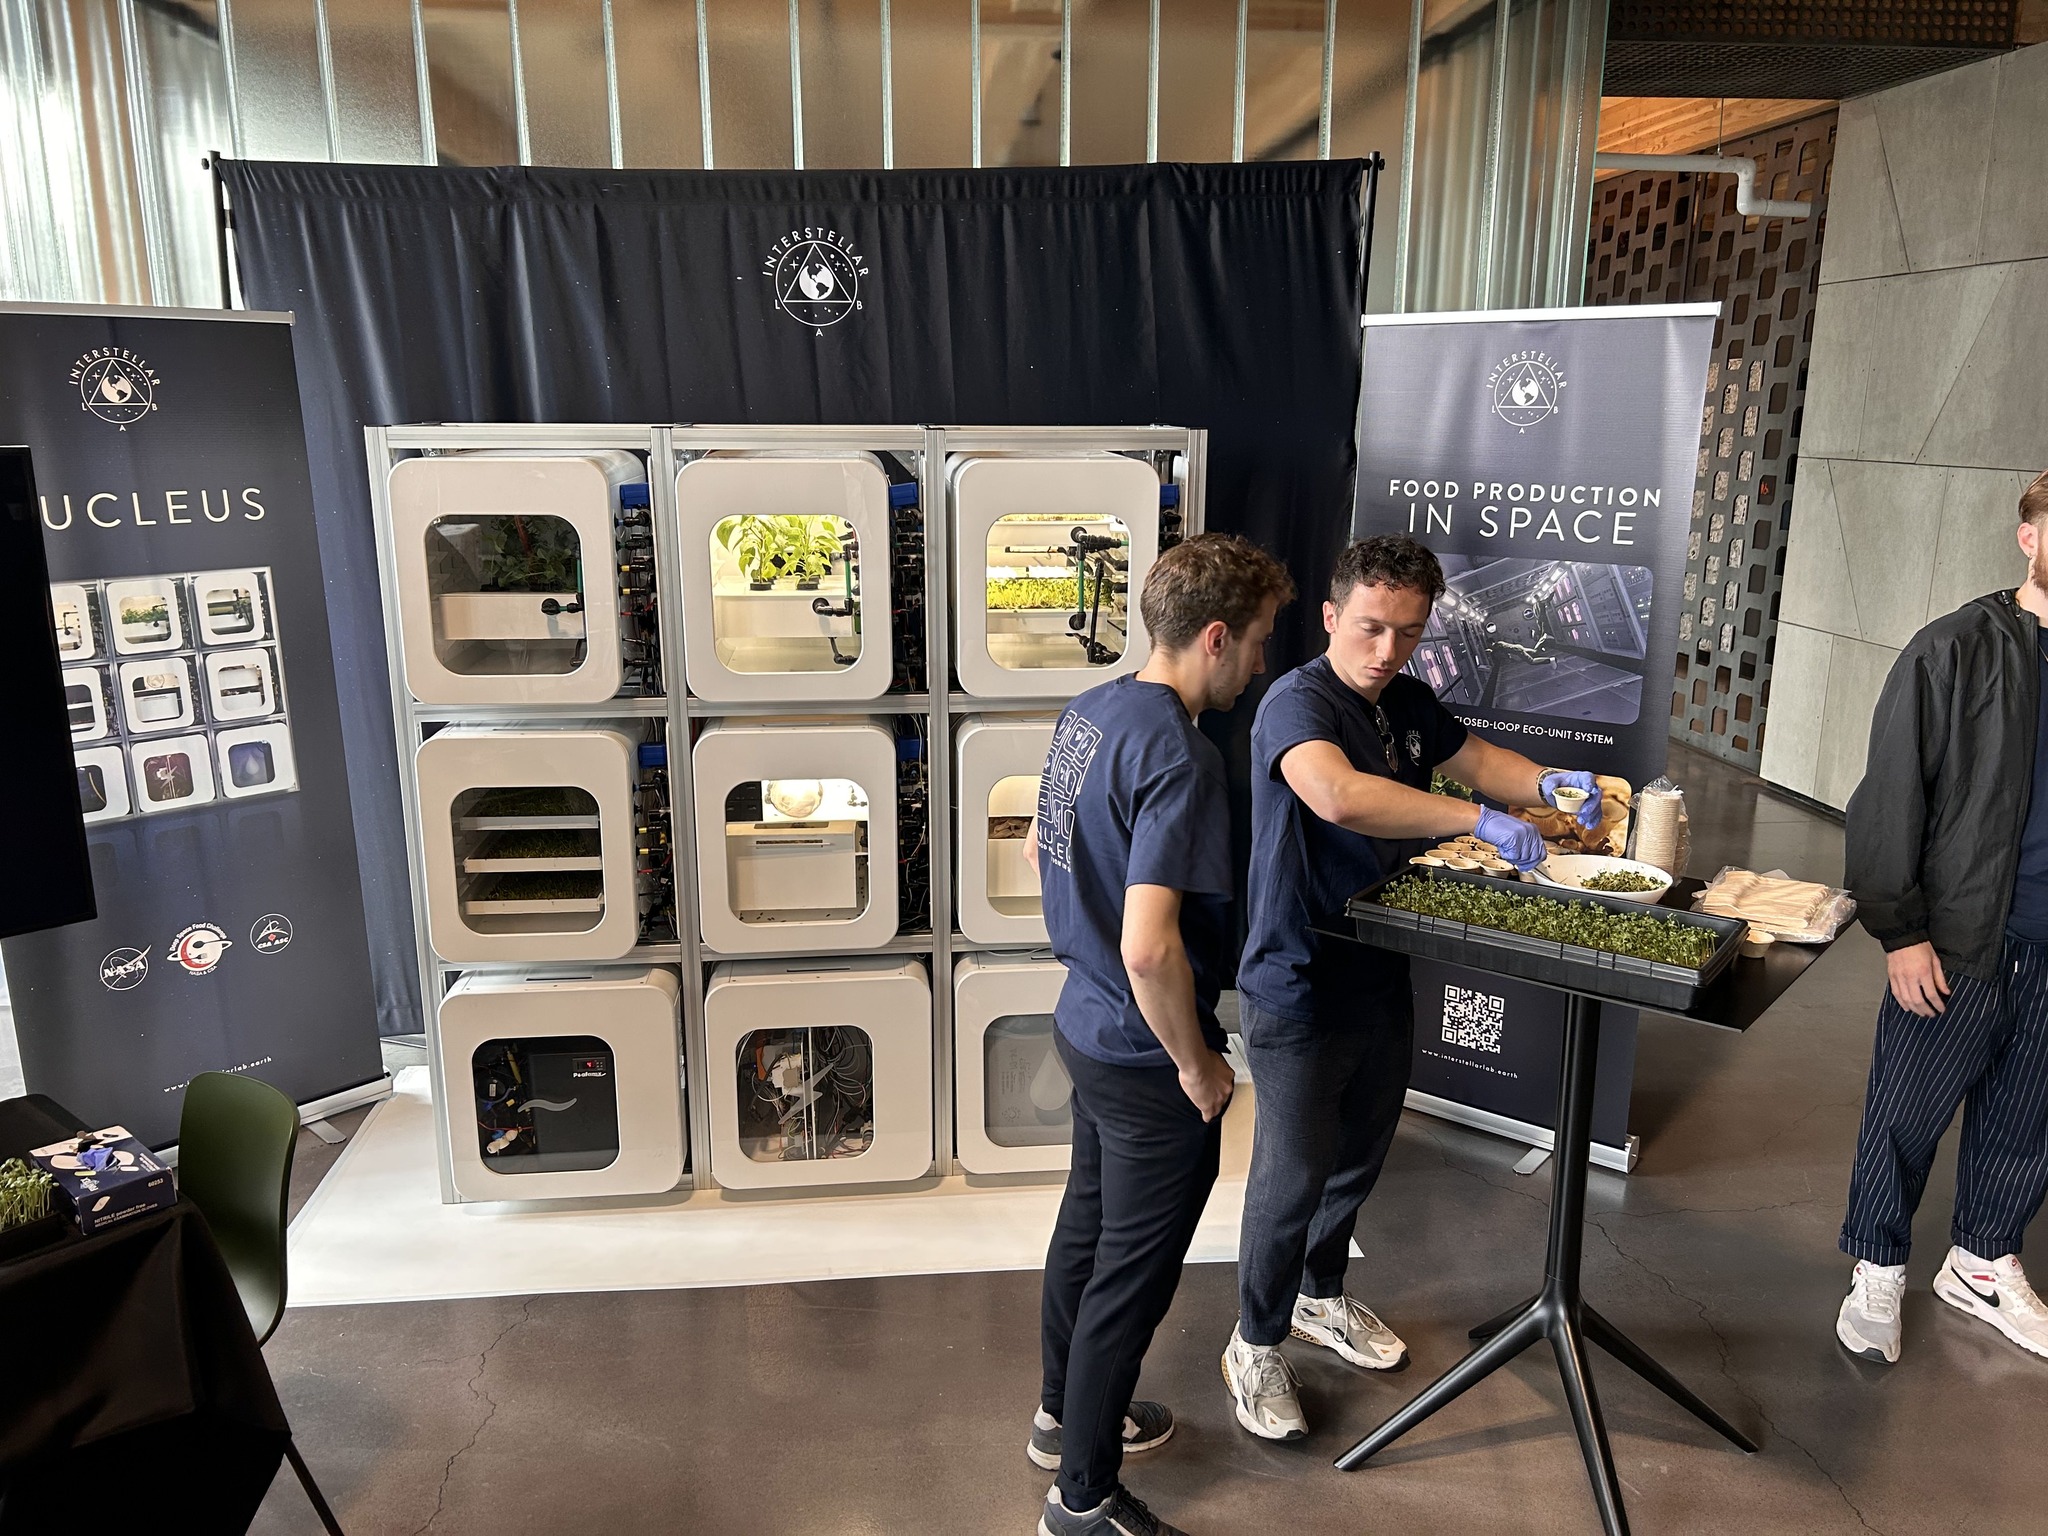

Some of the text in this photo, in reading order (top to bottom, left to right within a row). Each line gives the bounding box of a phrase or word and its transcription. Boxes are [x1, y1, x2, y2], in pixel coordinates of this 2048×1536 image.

[762, 227, 869, 277] INTERSTELLAR
[68, 347, 161, 385] INTERSTELLAR
[1486, 350, 1567, 388] INTERSTELLAR
[39, 487, 266, 531] UCLEUS
[1389, 479, 1661, 508] FOOD PRODUCTION
[1408, 502, 1638, 546] IN SPACE
[1453, 715, 1614, 746] LOSED-LOOP ECO-UNIT SYSTEM
[192, 922, 206, 930] Food
[103, 960, 146, 979] NASA
[1421, 1047, 1519, 1079] www.interstellarlab.earth
